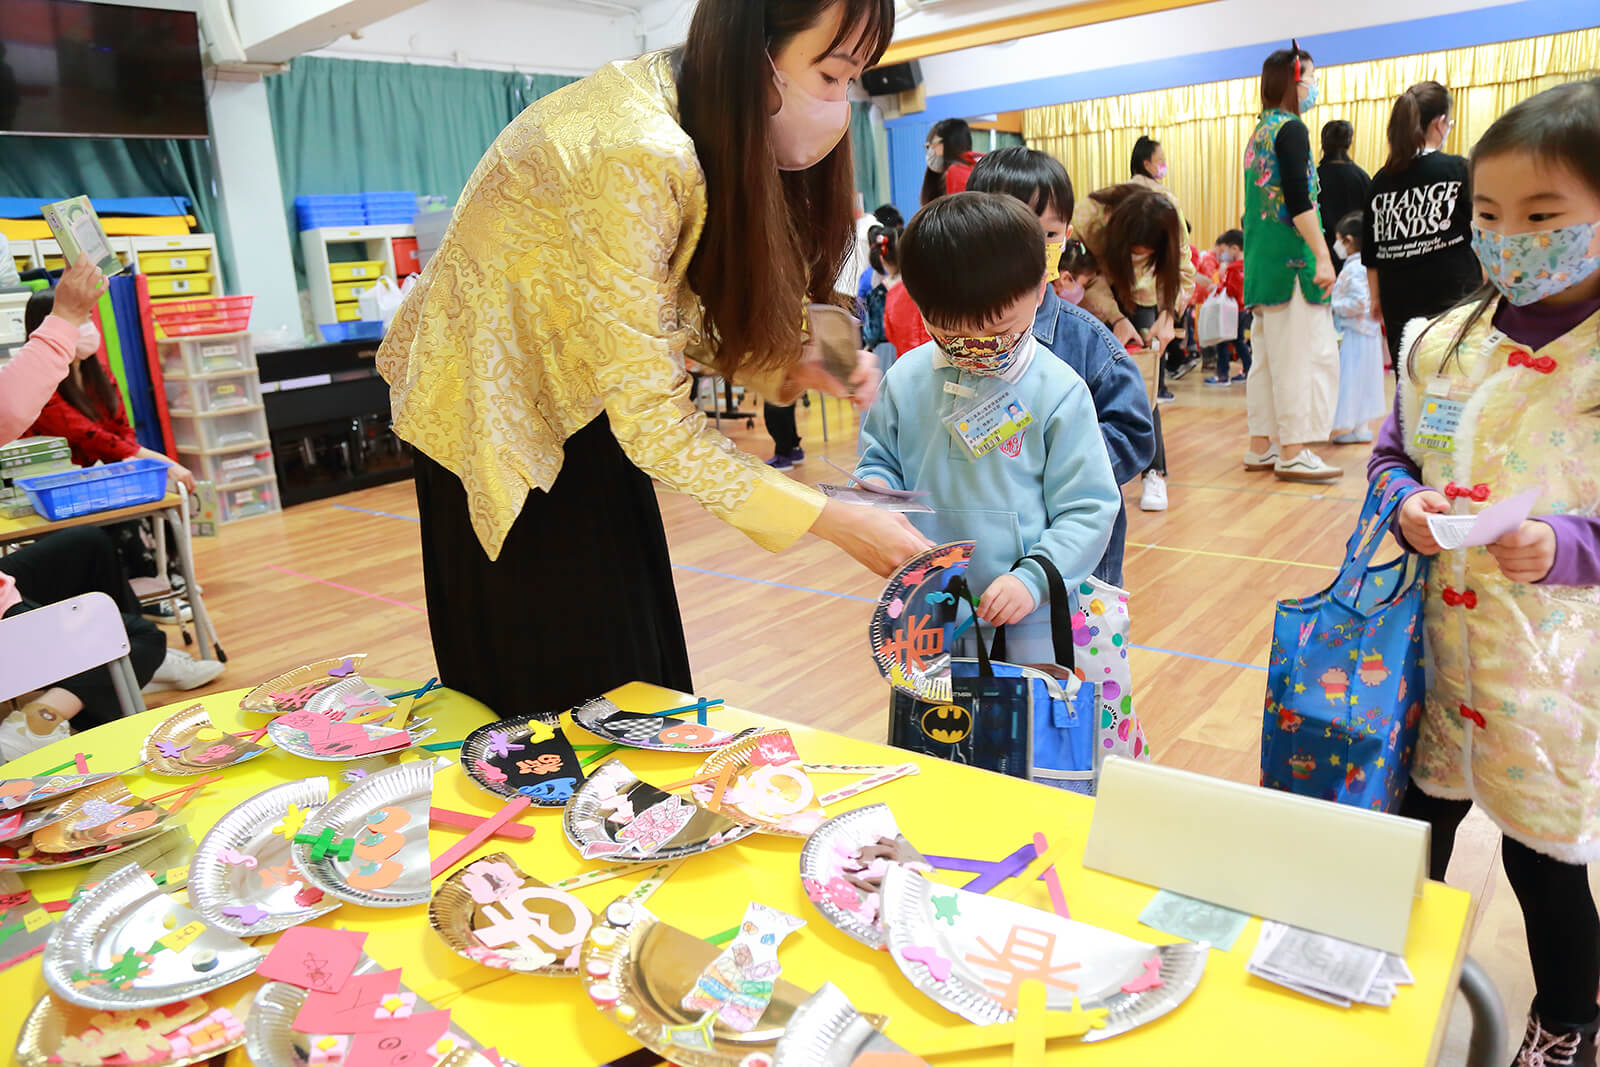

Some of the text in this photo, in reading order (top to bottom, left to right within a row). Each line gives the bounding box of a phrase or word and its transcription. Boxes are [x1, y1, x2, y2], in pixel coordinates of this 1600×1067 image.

[1371, 181, 1462, 212] CHANGE
[1386, 207, 1403, 224] IN
[1405, 201, 1442, 221] OUR
